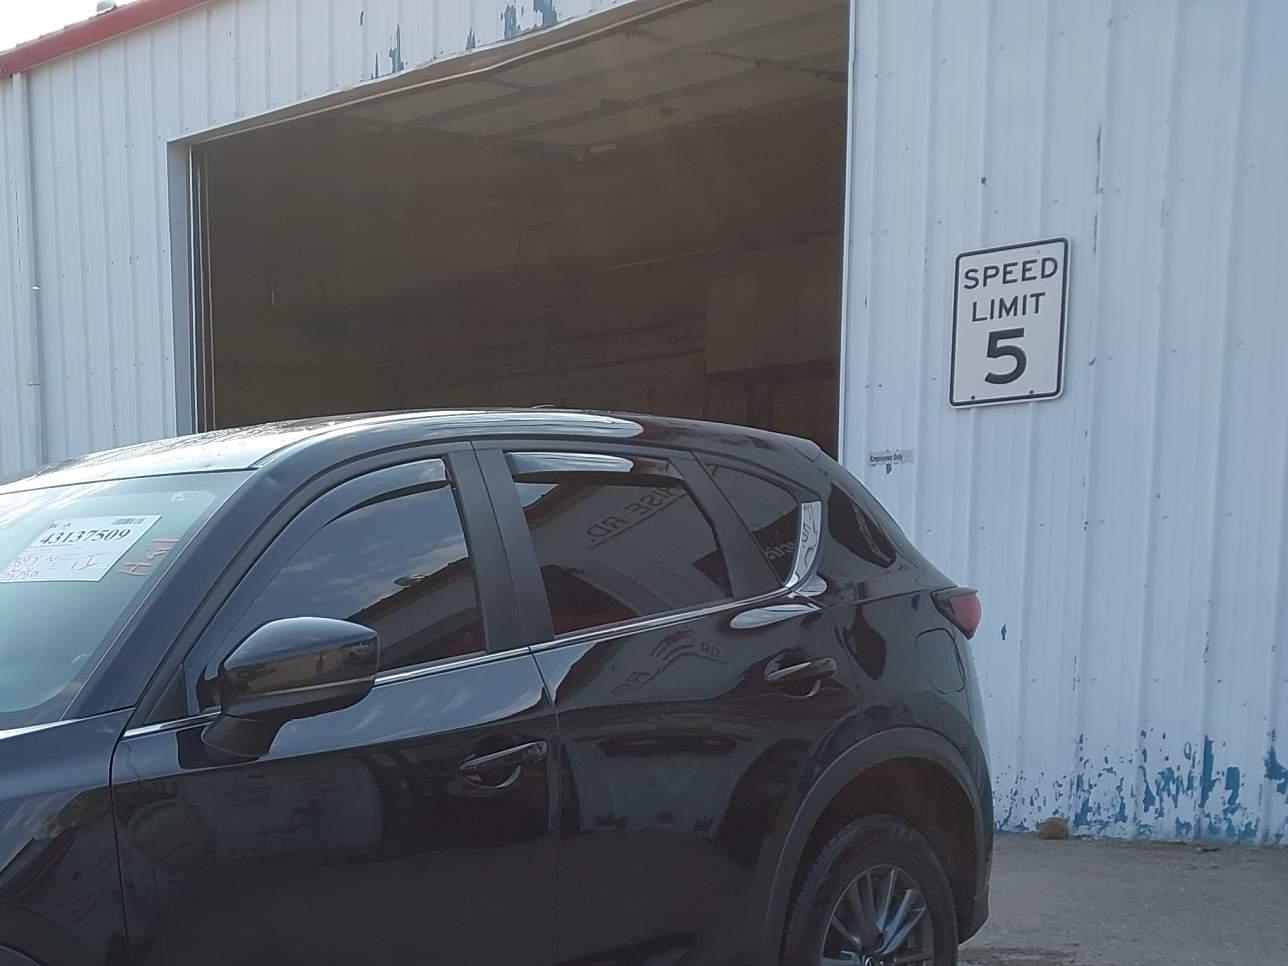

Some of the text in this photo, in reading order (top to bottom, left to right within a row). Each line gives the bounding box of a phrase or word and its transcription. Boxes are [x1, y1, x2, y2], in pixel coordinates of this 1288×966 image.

[963, 256, 1058, 289] SPEED
[972, 292, 1046, 322] LIMIT
[984, 327, 1027, 385] 5
[40, 528, 131, 545] 43137509
